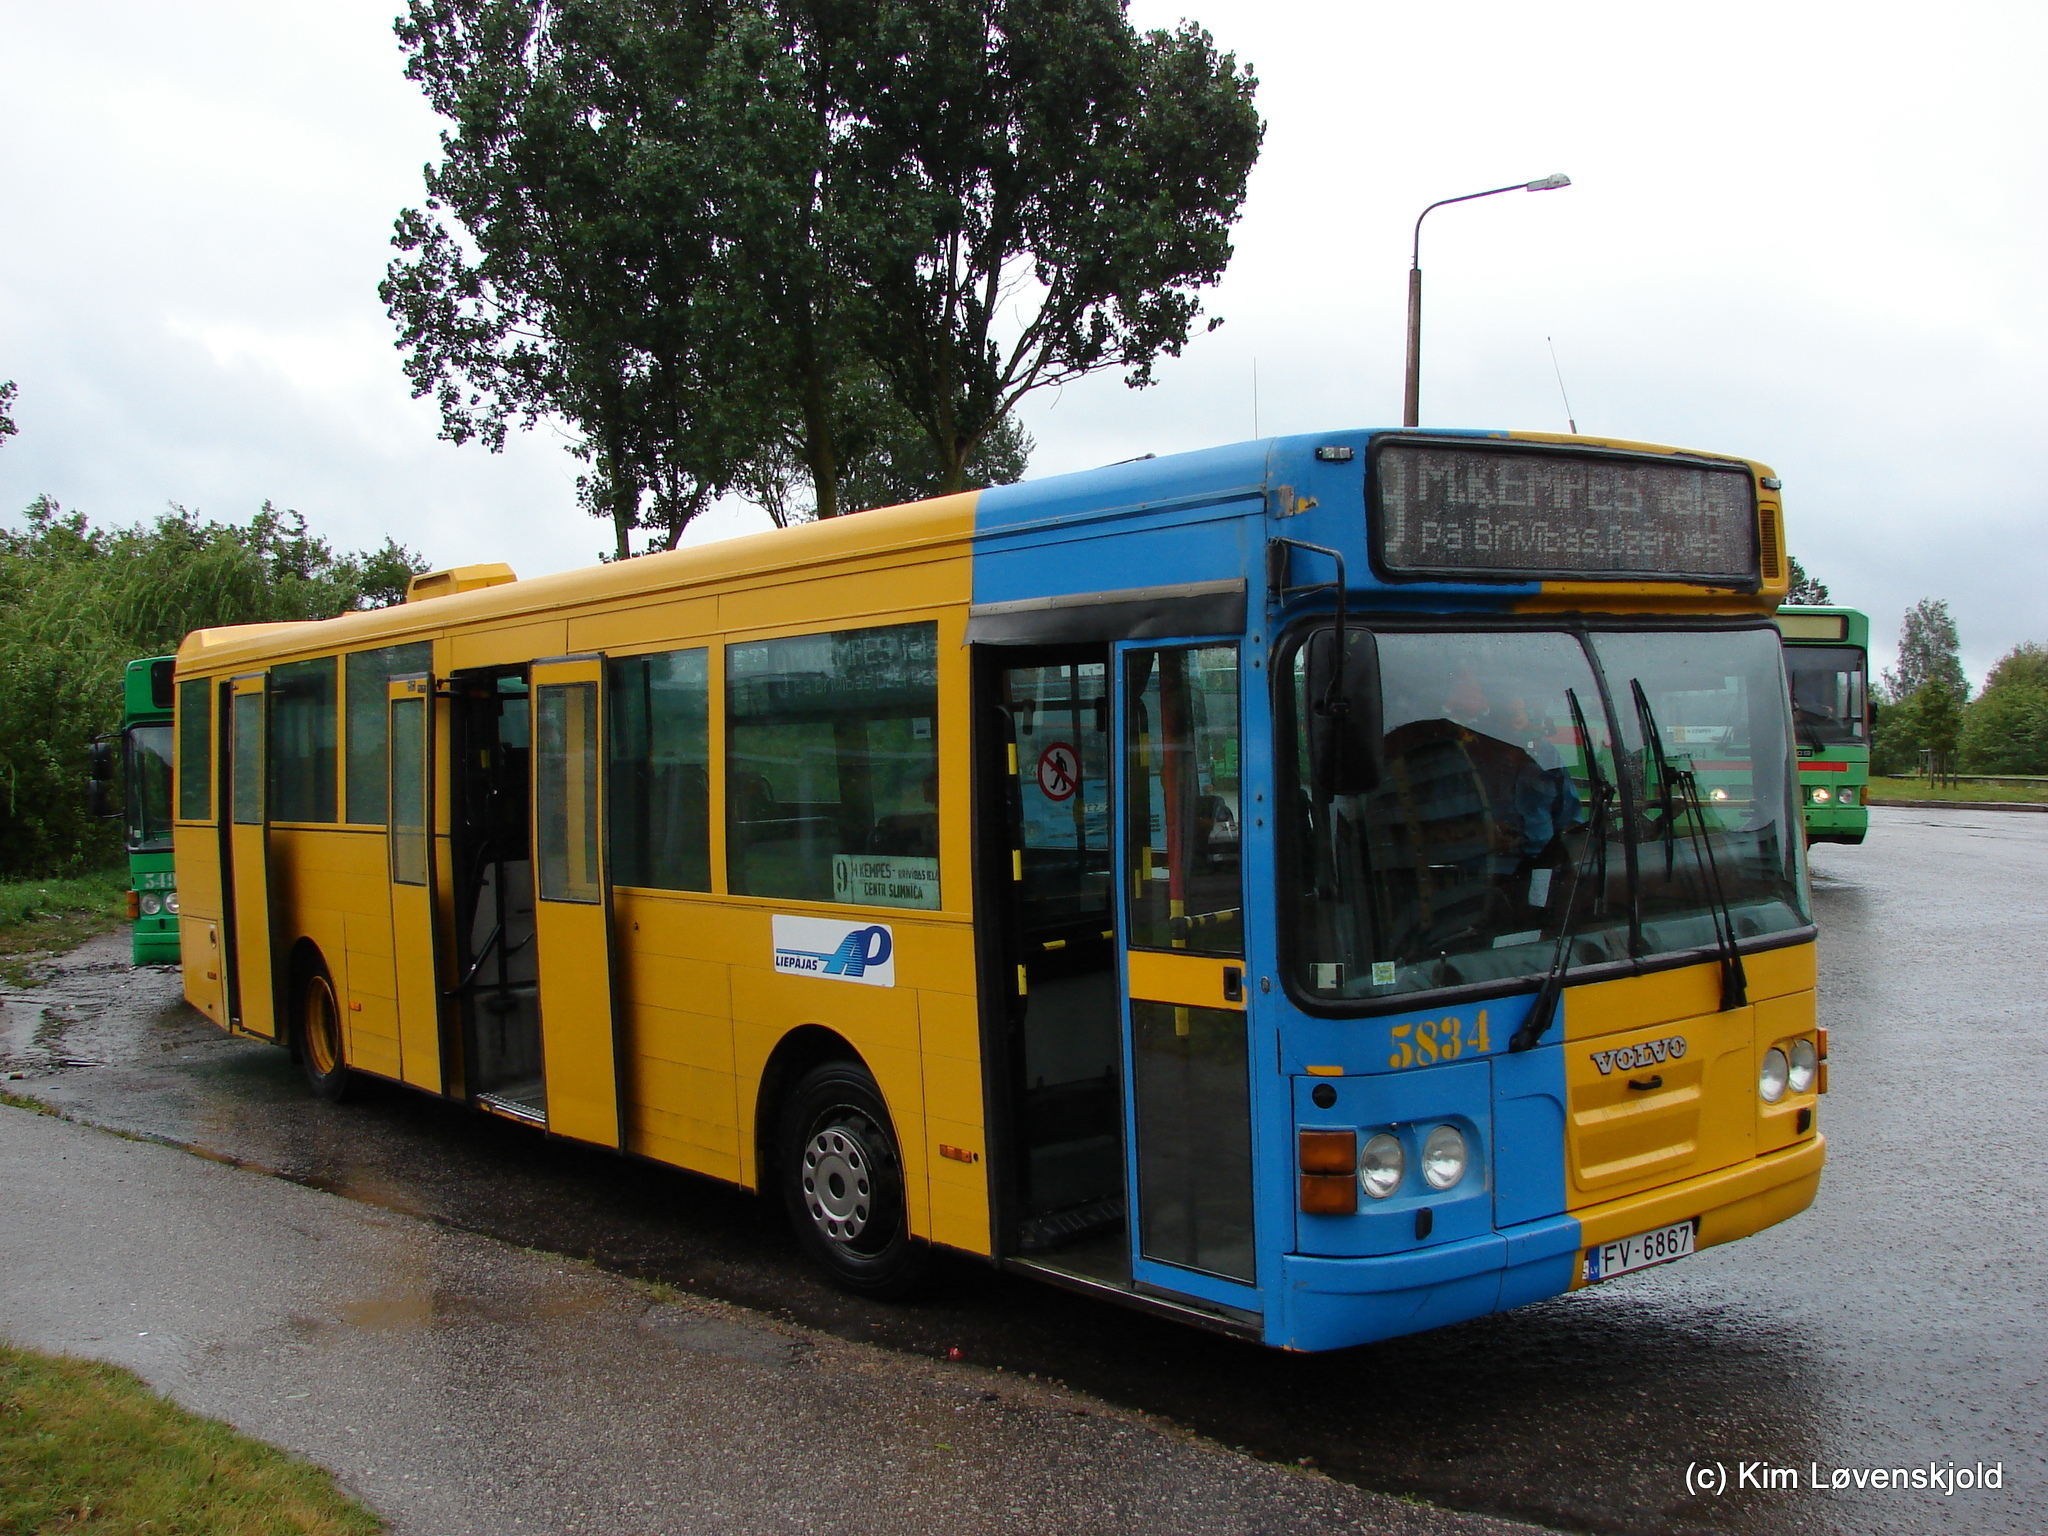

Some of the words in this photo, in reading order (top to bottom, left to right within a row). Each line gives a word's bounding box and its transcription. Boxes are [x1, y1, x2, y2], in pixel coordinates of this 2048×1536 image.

[837, 860, 847, 892] 9
[860, 863, 892, 878] KEMPES
[1389, 1009, 1491, 1069] 5834
[1591, 1035, 1687, 1075] VOLVO
[1603, 1224, 1690, 1272] FV-6867
